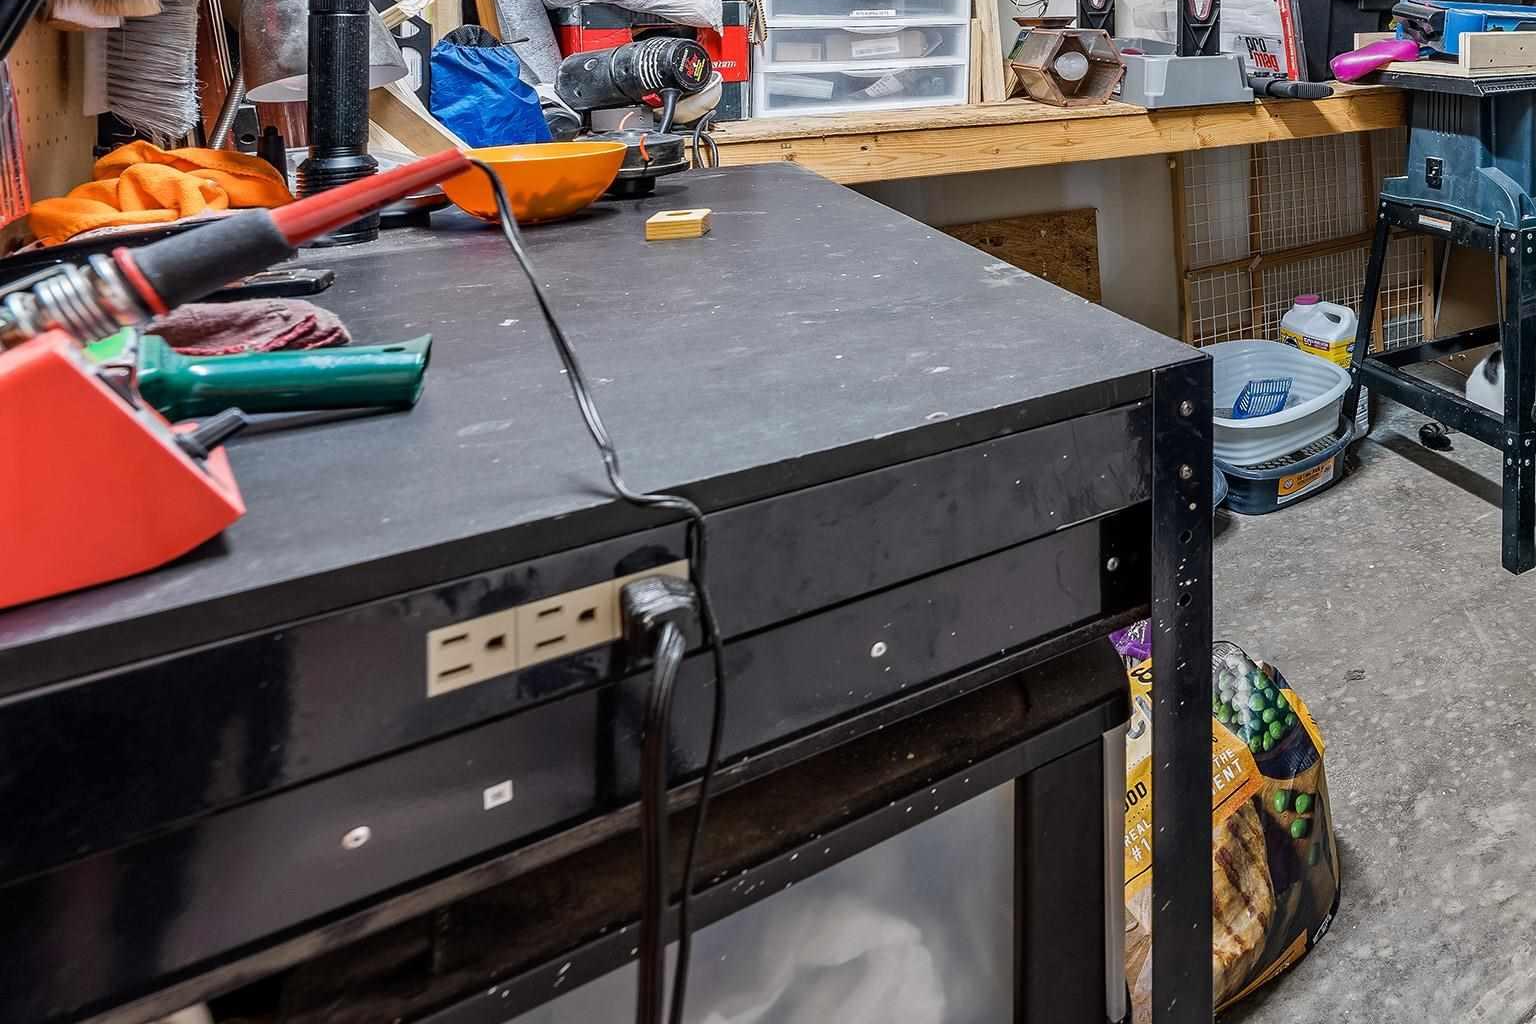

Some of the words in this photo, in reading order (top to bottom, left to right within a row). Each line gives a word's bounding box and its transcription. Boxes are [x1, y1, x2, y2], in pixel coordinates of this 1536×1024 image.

[1245, 36, 1267, 59] pro
[1253, 52, 1280, 73] mag
[1124, 817, 1152, 848] REAL
[1213, 747, 1236, 771] THE
